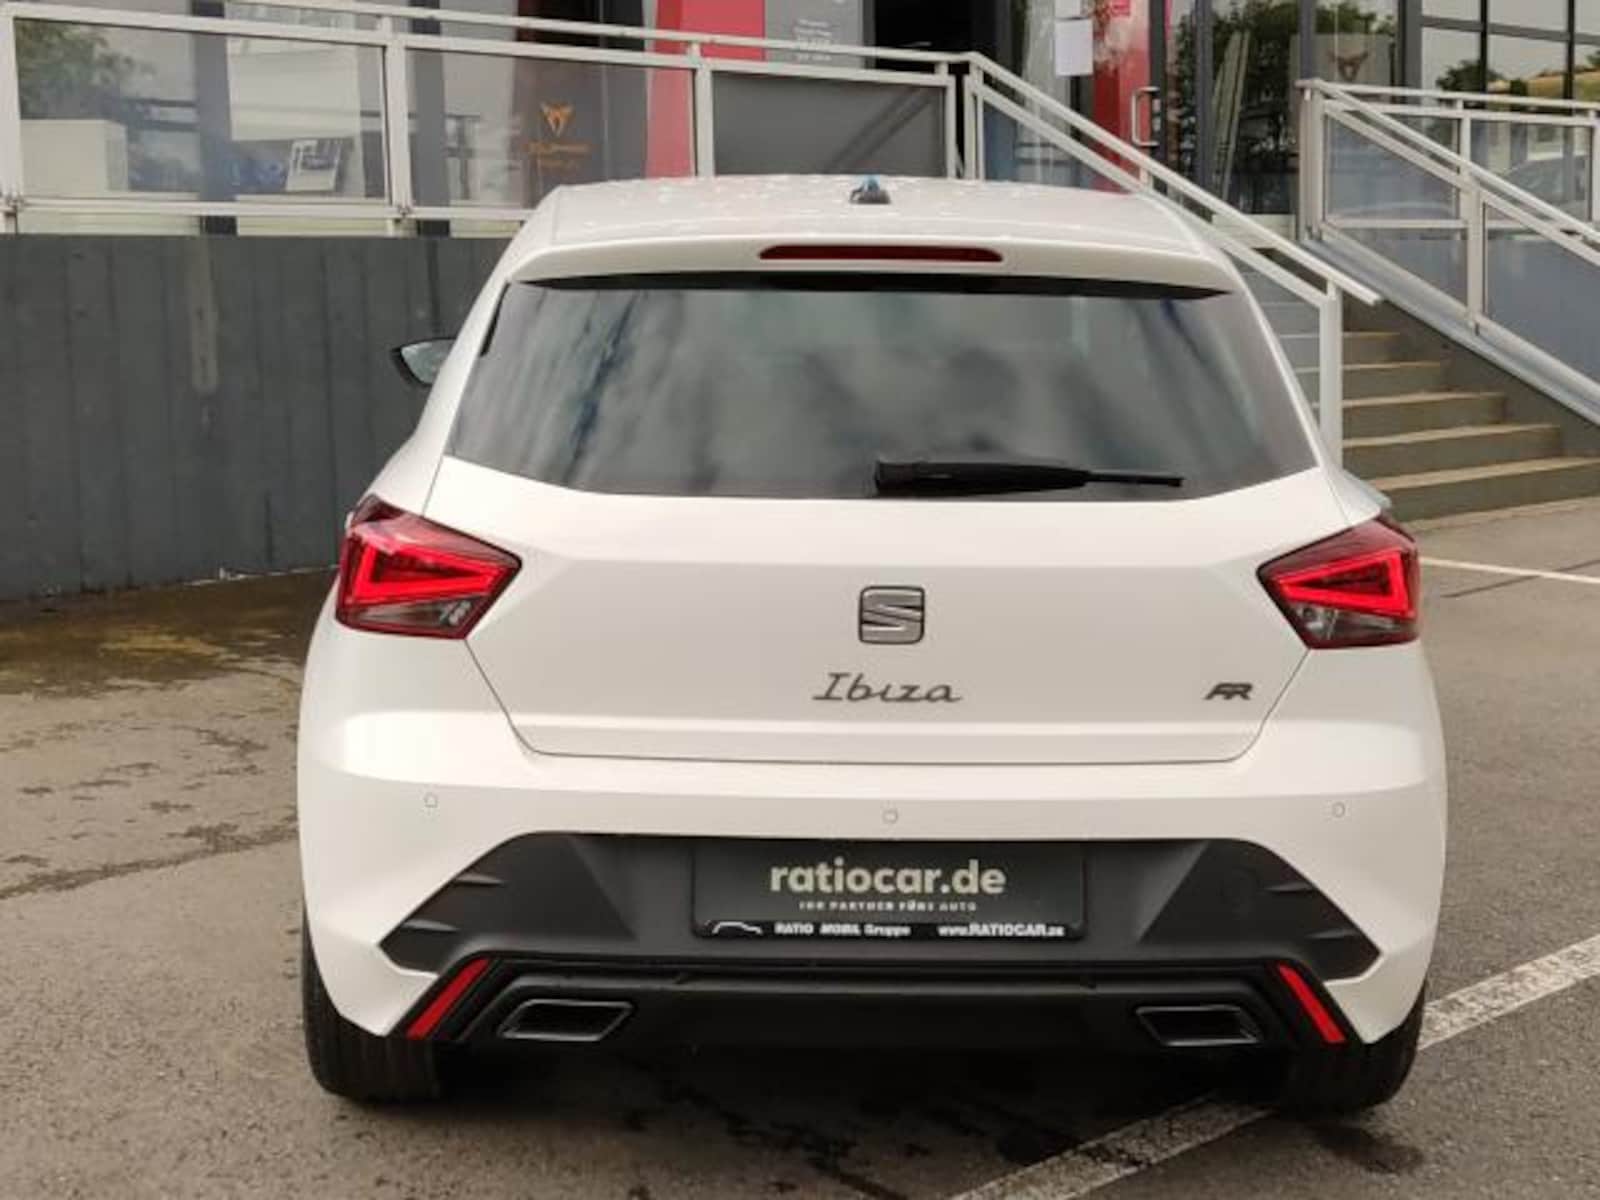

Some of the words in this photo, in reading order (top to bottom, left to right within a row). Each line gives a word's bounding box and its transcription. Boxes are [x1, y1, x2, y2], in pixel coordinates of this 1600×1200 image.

[812, 672, 964, 703] Ibiza
[1204, 682, 1253, 701] FR
[769, 856, 1007, 894] ratiocar.de
[774, 922, 815, 935] RATIO
